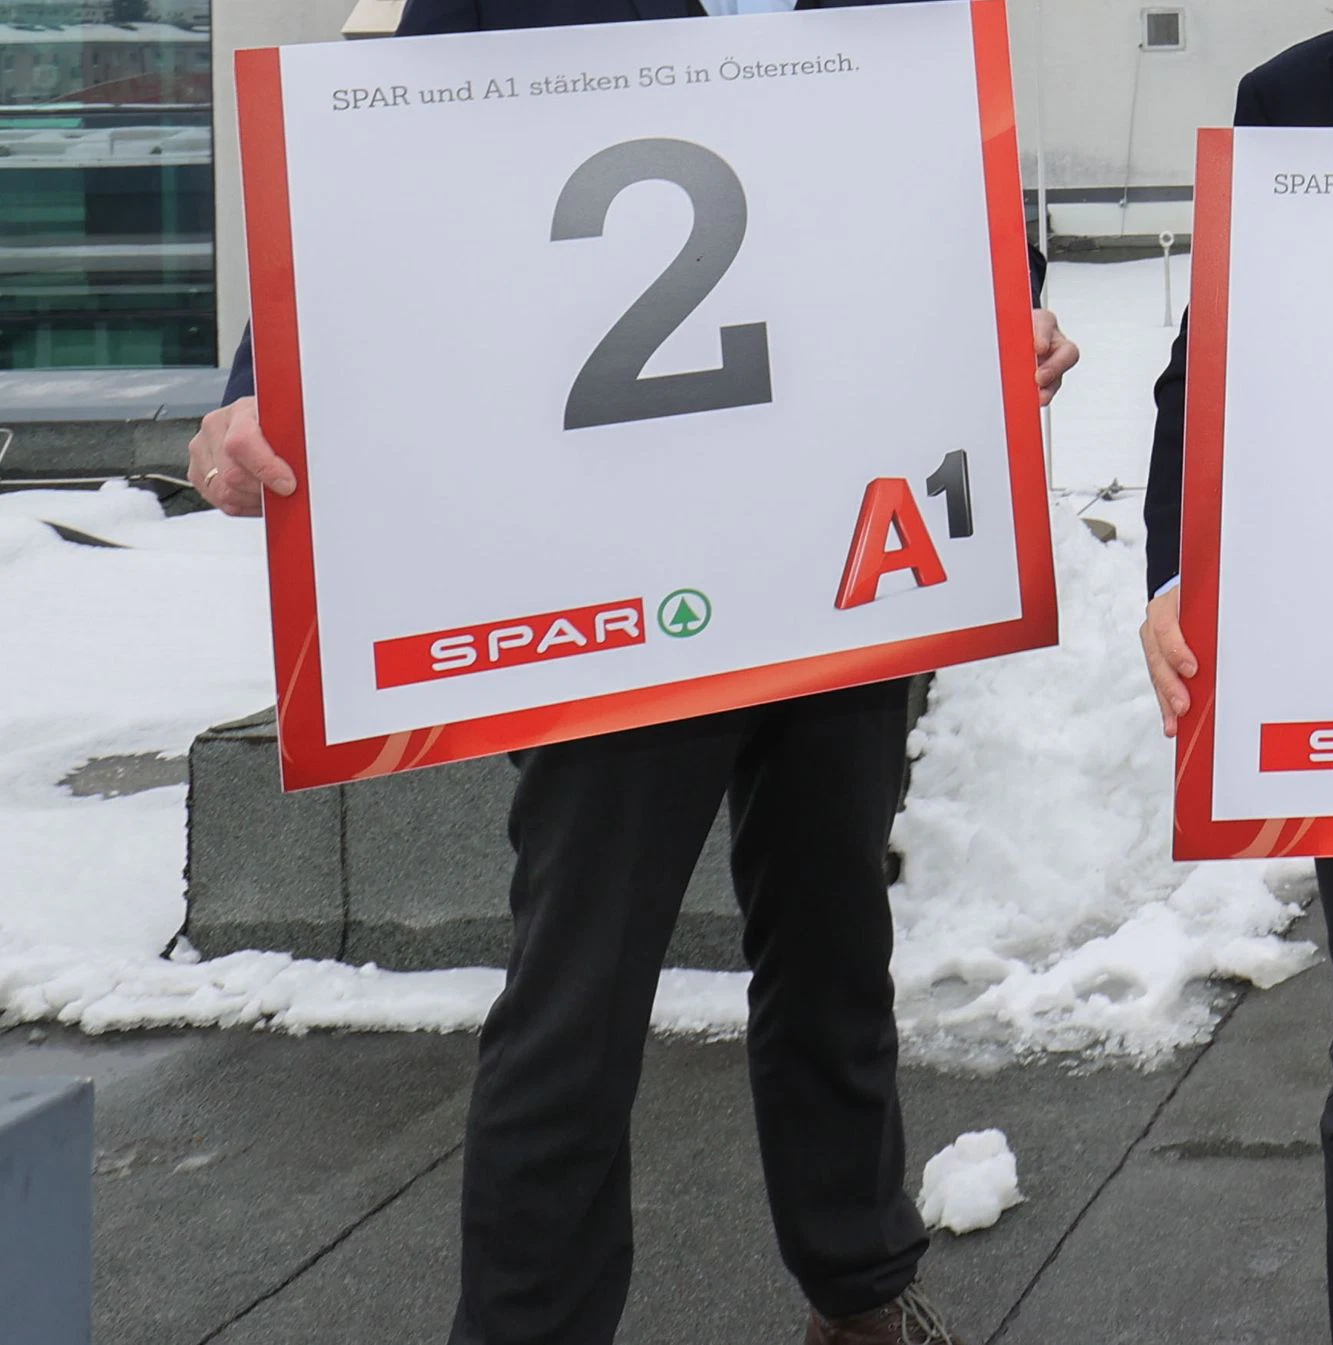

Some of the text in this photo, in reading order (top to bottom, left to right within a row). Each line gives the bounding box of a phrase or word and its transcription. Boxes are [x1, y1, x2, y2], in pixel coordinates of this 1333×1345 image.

[333, 52, 859, 111] SPAR und A1 stärken 5G in Österreich.
[549, 138, 773, 431] 2
[834, 449, 974, 611] A1
[430, 607, 640, 672] SPAR
